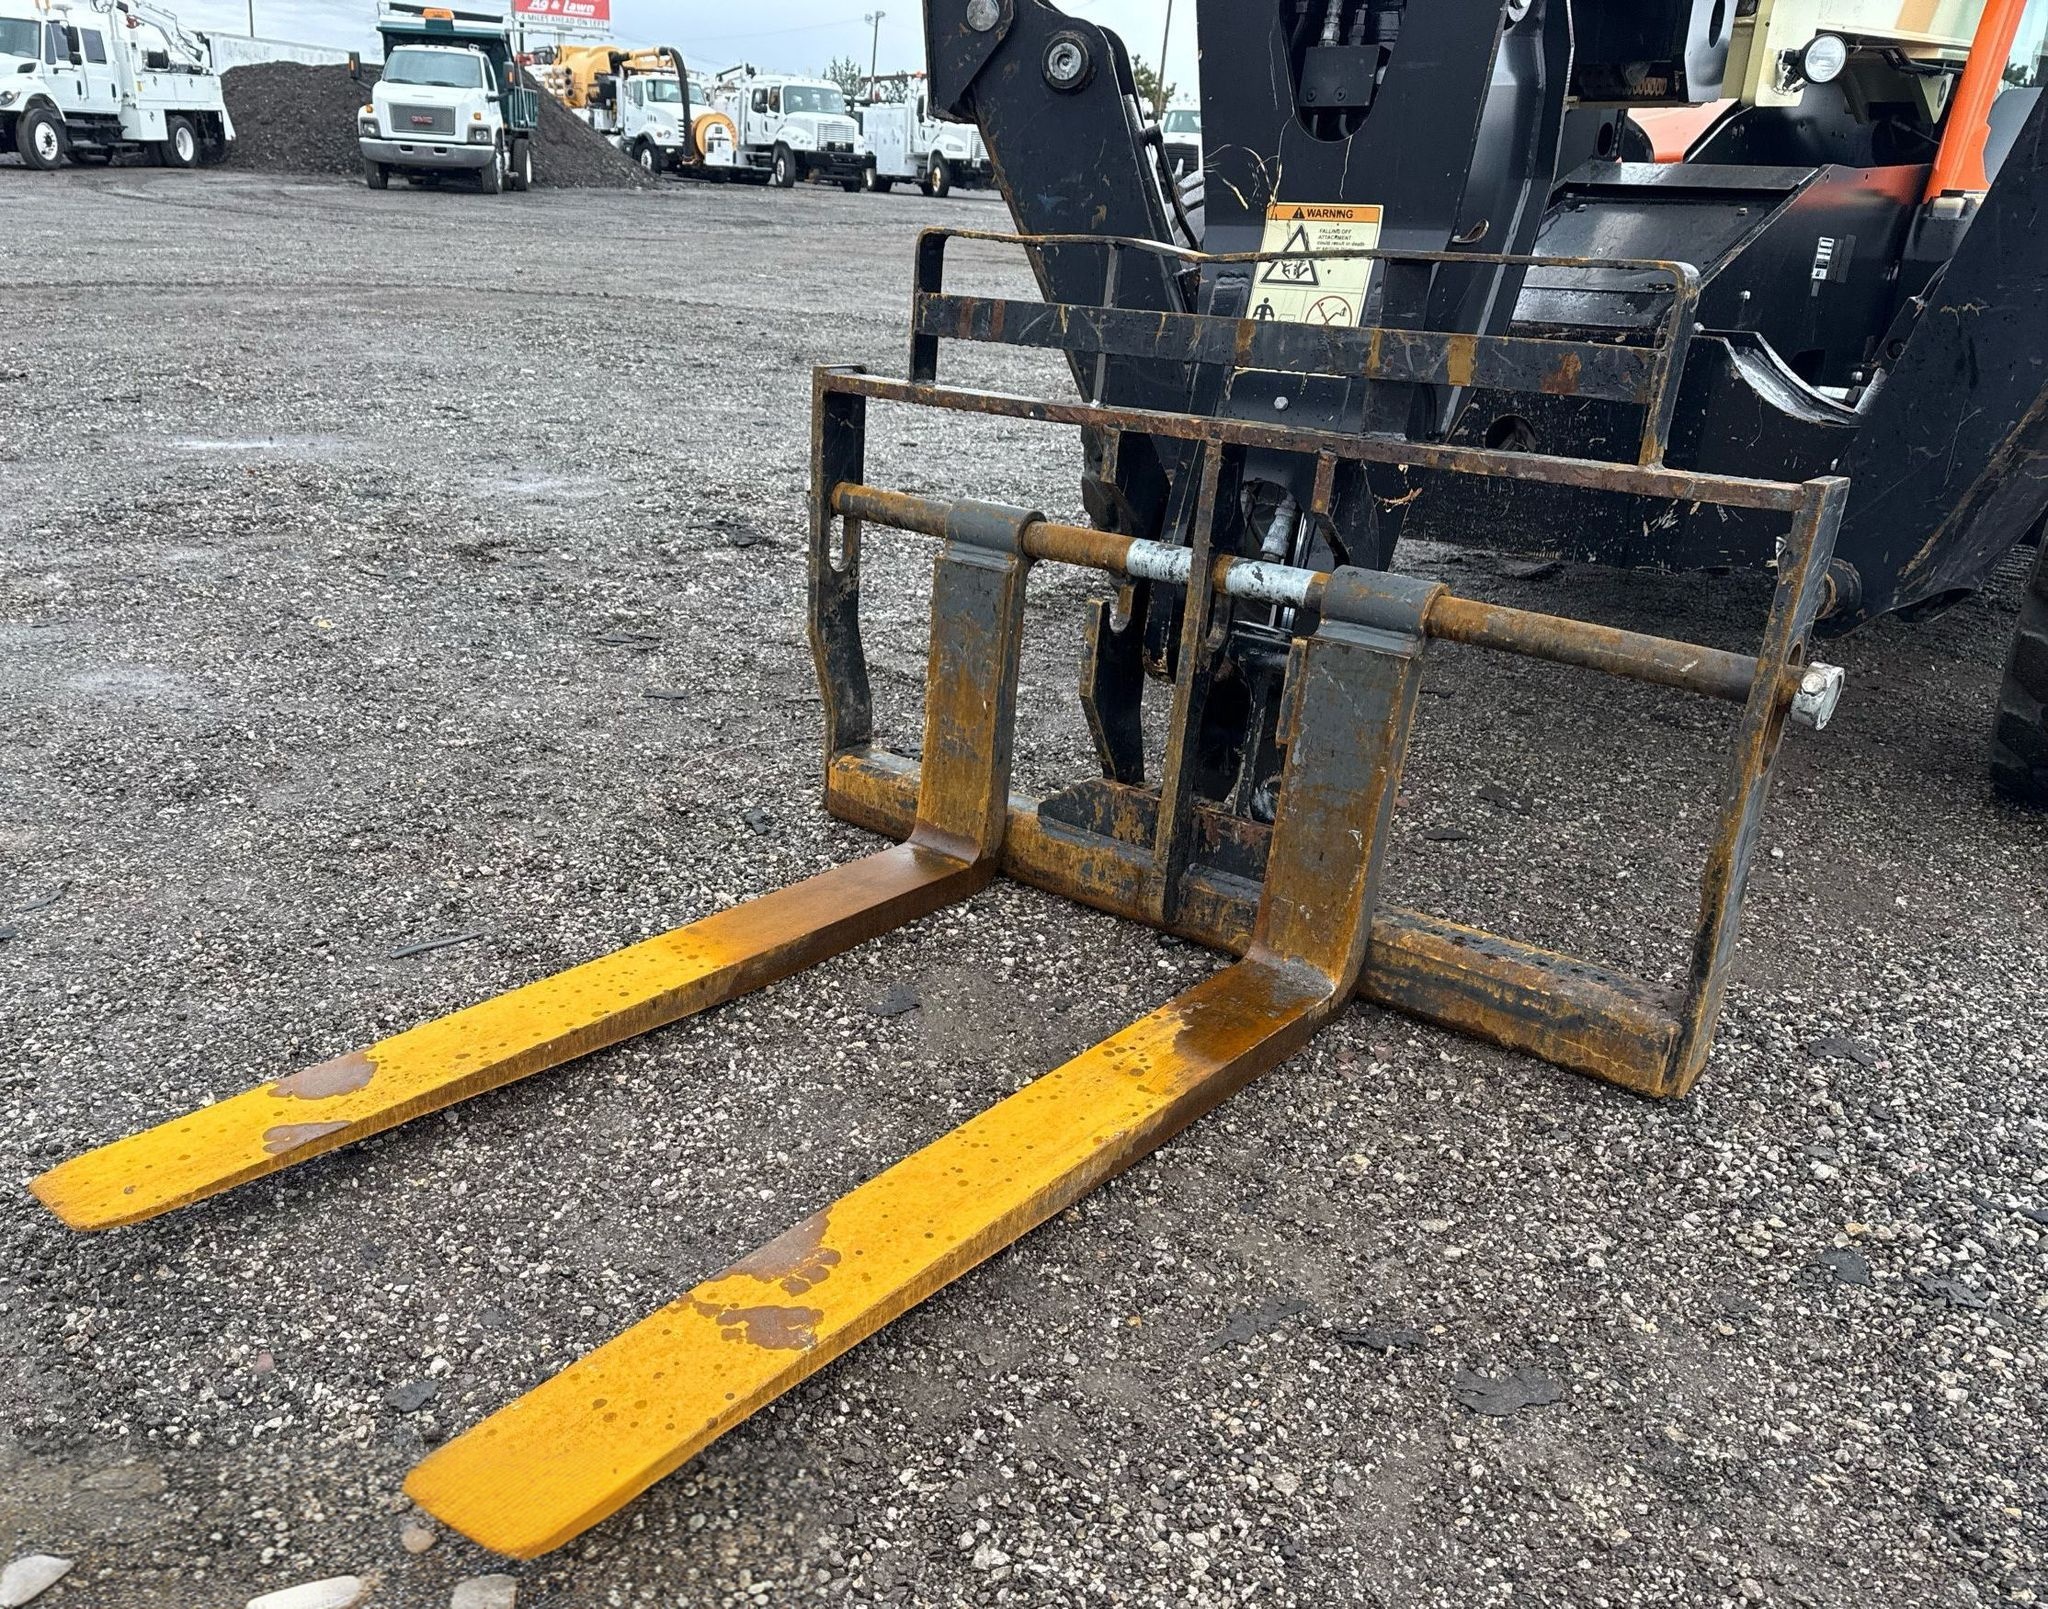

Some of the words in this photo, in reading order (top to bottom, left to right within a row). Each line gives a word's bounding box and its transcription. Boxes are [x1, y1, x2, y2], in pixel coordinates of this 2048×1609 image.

[528, 0, 549, 11] Ag
[551, 0, 560, 10] &
[562, 0, 595, 15] Lawn
[551, 16, 575, 24] AHEAD
[1307, 208, 1353, 219] WARNING
